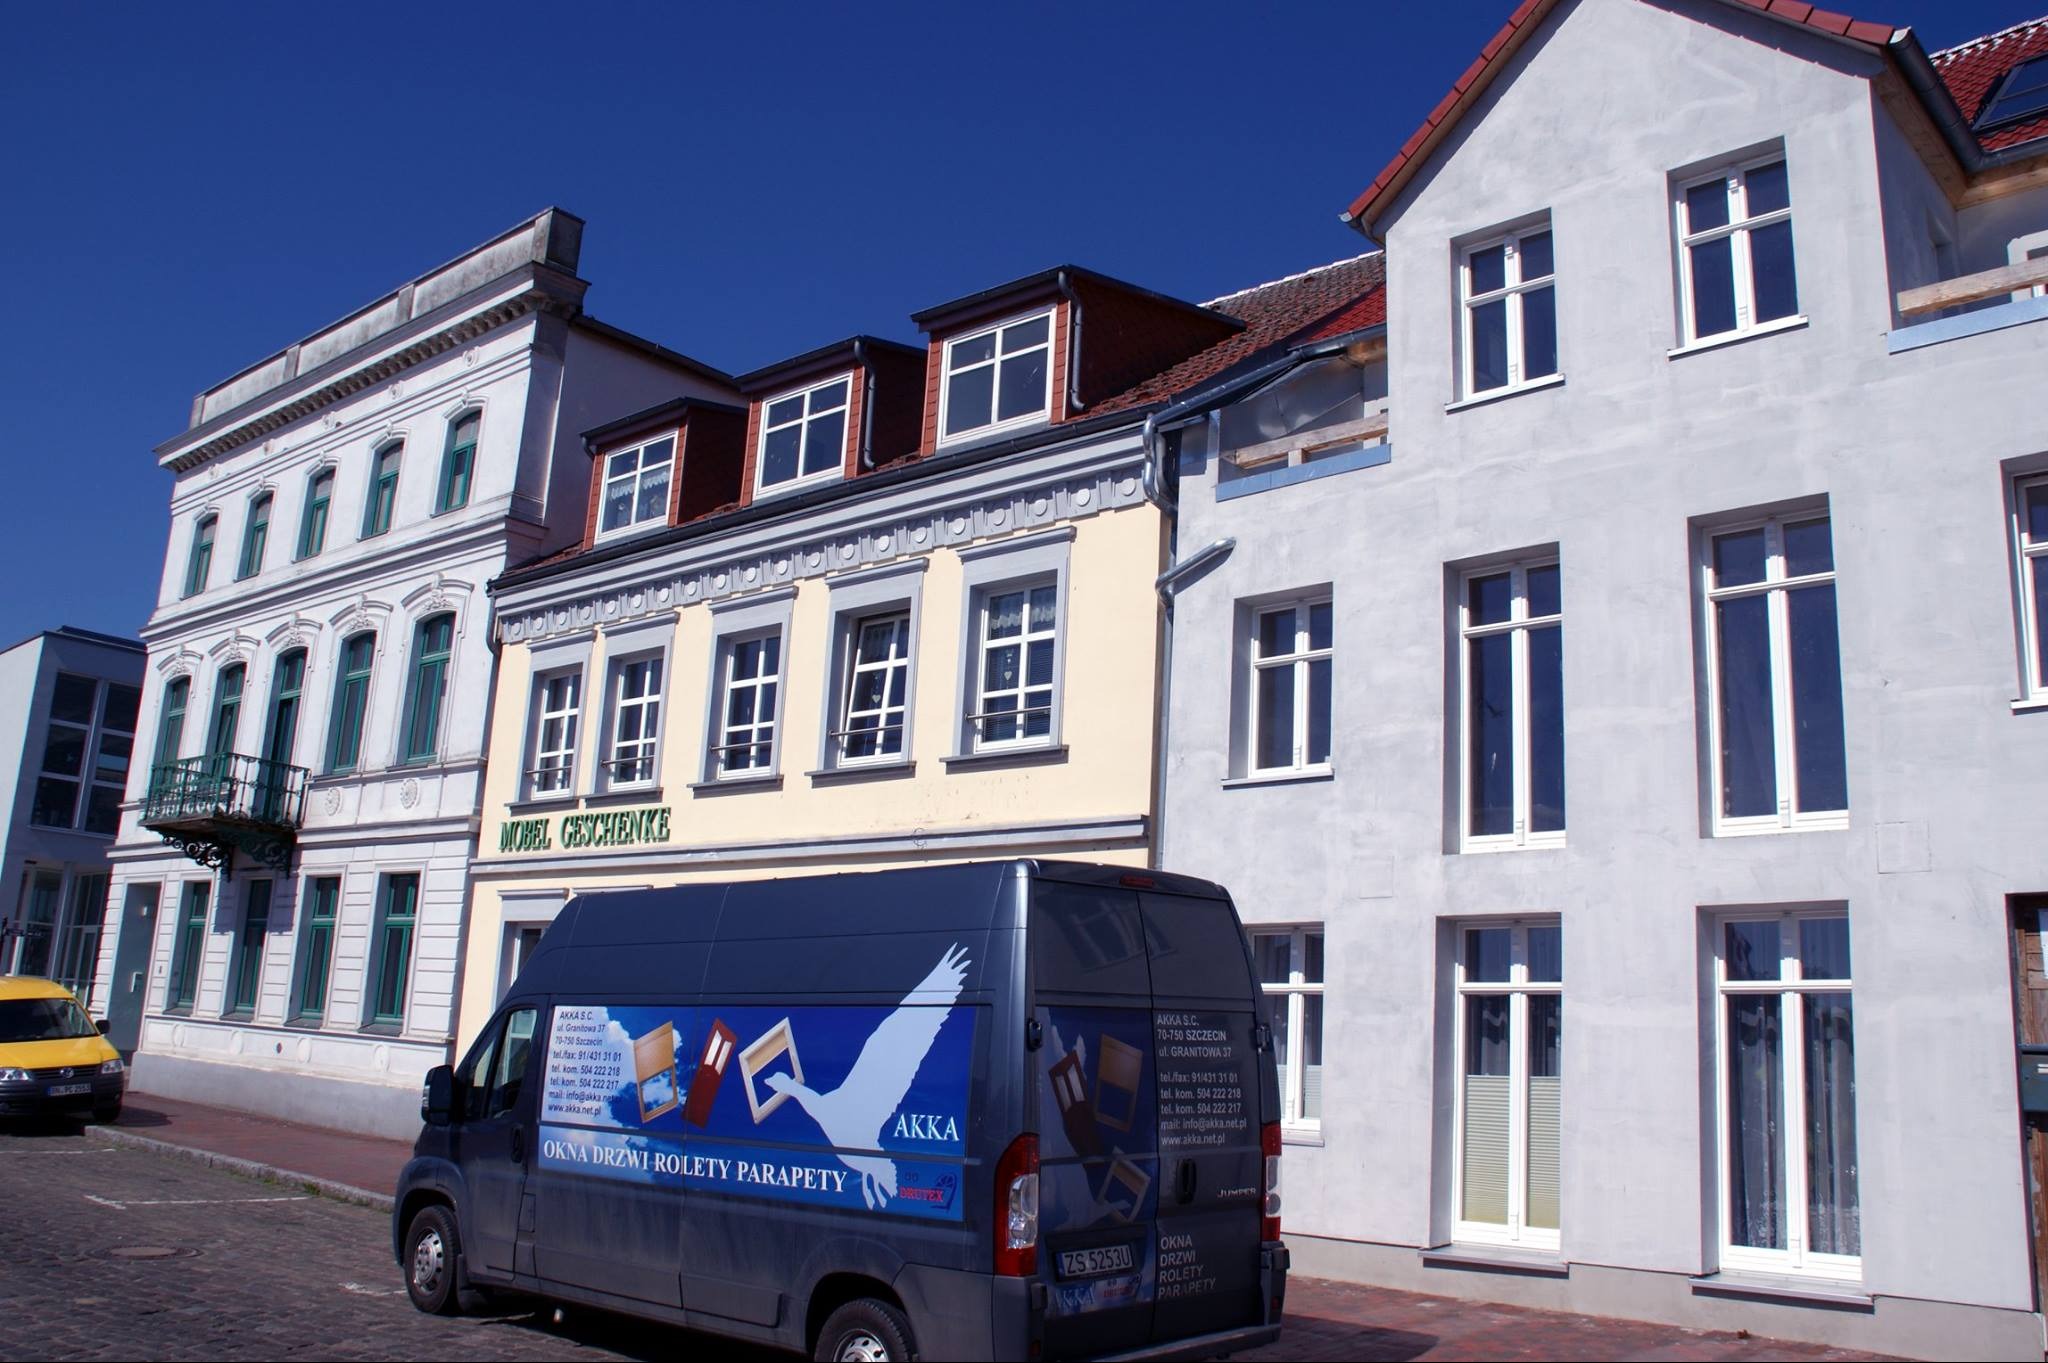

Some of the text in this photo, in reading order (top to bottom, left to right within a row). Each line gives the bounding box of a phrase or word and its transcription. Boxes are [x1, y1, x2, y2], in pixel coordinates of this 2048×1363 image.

[560, 807, 671, 849] GESCHENKE
[560, 1011, 579, 1020] AKKA
[1157, 1014, 1200, 1026] AKKA S.C.
[566, 1023, 596, 1033] Granitowa
[597, 1024, 606, 1033] 37
[555, 1036, 603, 1046] 70-750 Szczecin
[1157, 1029, 1227, 1041] 70-750 SZCZECIN
[578, 1051, 601, 1061] 91/431
[603, 1052, 611, 1061] 31
[613, 1052, 622, 1062] 01
[1159, 1046, 1232, 1058] ul. GRANITOWA 37
[563, 1064, 579, 1074] kom.
[580, 1065, 593, 1075] 504
[594, 1066, 606, 1076] 222
[607, 1066, 620, 1077] 218
[561, 1077, 577, 1087] kom.
[579, 1079, 591, 1088] 504
[592, 1079, 605, 1089] 222
[606, 1080, 620, 1090] 217
[1160, 1072, 1238, 1083] tel./fax: 91/431 31 01
[1160, 1088, 1242, 1099] tel. kom. 504 222 218
[548, 1103, 602, 1116] www.akka.net.pl
[1160, 1103, 1241, 1114] tel. kom. 504 222 217
[892, 1113, 960, 1141] AKKA
[1161, 1118, 1247, 1132] mail: info@akka.net.pl
[1161, 1133, 1226, 1146] www.akka.net.pl
[544, 1139, 847, 1192] OKNA DRZWI ROLETY PARAPETY
[1217, 1187, 1257, 1198] JUMPER
[1160, 1234, 1193, 1250] OKNA
[1064, 1253, 1087, 1274] ZS
[1088, 1247, 1131, 1271] 5253U
[1160, 1250, 1196, 1267] DRZWI
[1159, 1265, 1205, 1283] ROLETY
[1158, 1278, 1217, 1300] PARAPETY
